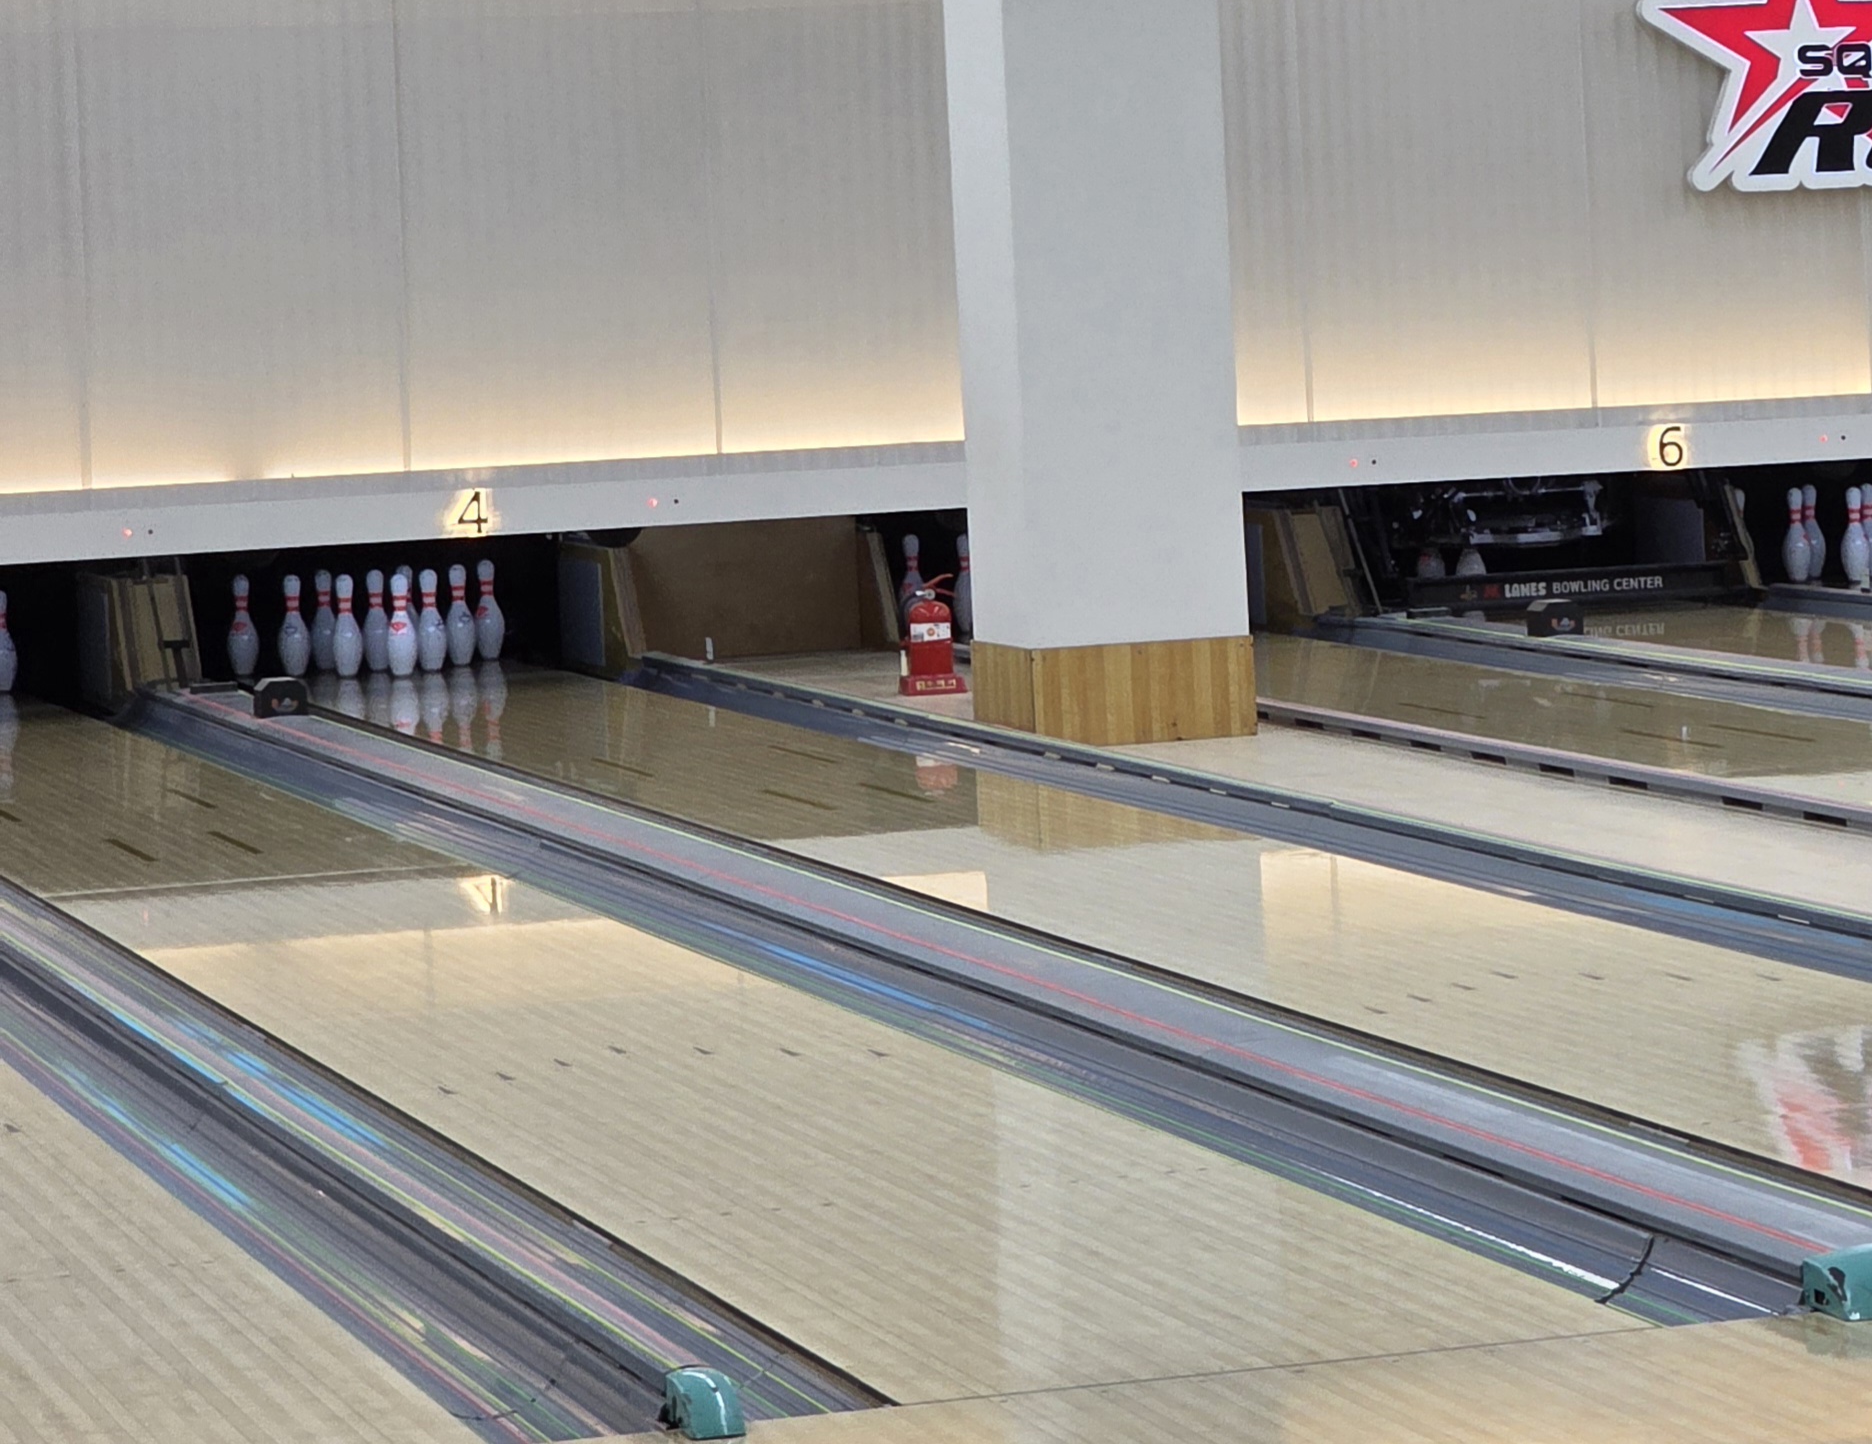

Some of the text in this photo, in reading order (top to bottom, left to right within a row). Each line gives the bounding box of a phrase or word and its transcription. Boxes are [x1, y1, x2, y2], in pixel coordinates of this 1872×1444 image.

[1659, 425, 1684, 467] 6
[457, 490, 489, 534] 4
[1504, 581, 1547, 599] LANES
[1552, 579, 1610, 595] BOWLING
[1614, 575, 1664, 592] CENTER
